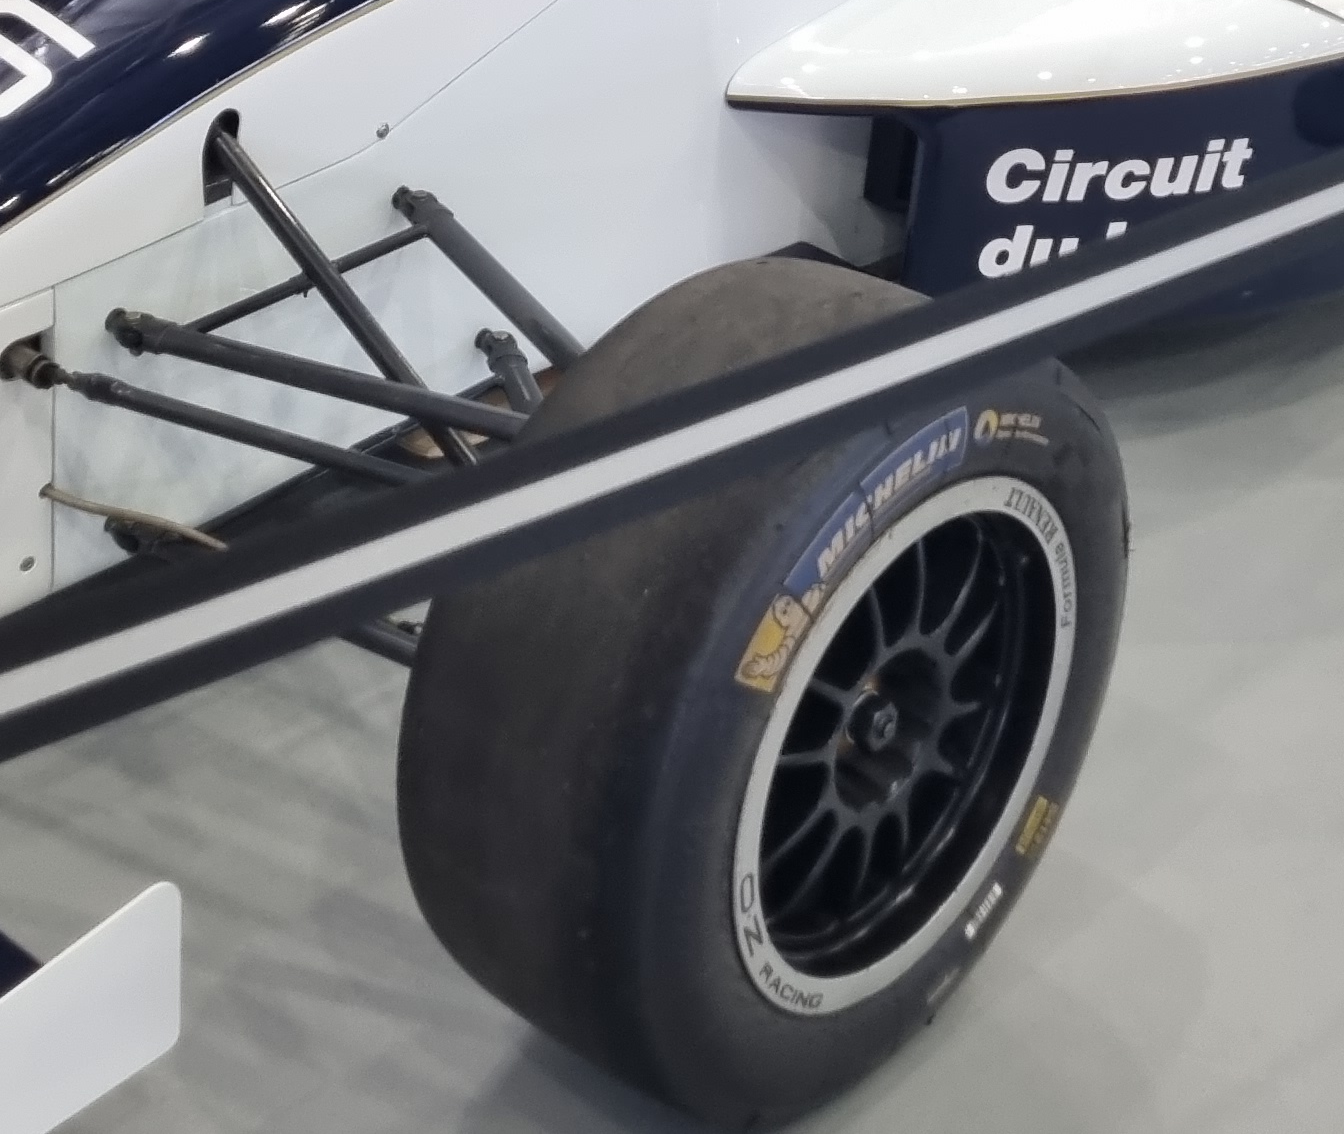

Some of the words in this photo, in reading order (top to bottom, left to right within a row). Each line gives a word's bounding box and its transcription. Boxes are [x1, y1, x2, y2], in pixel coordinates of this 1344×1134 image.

[986, 138, 1253, 204] Circuit
[818, 428, 961, 578] MICHELIN
[759, 961, 824, 1008] RACING
